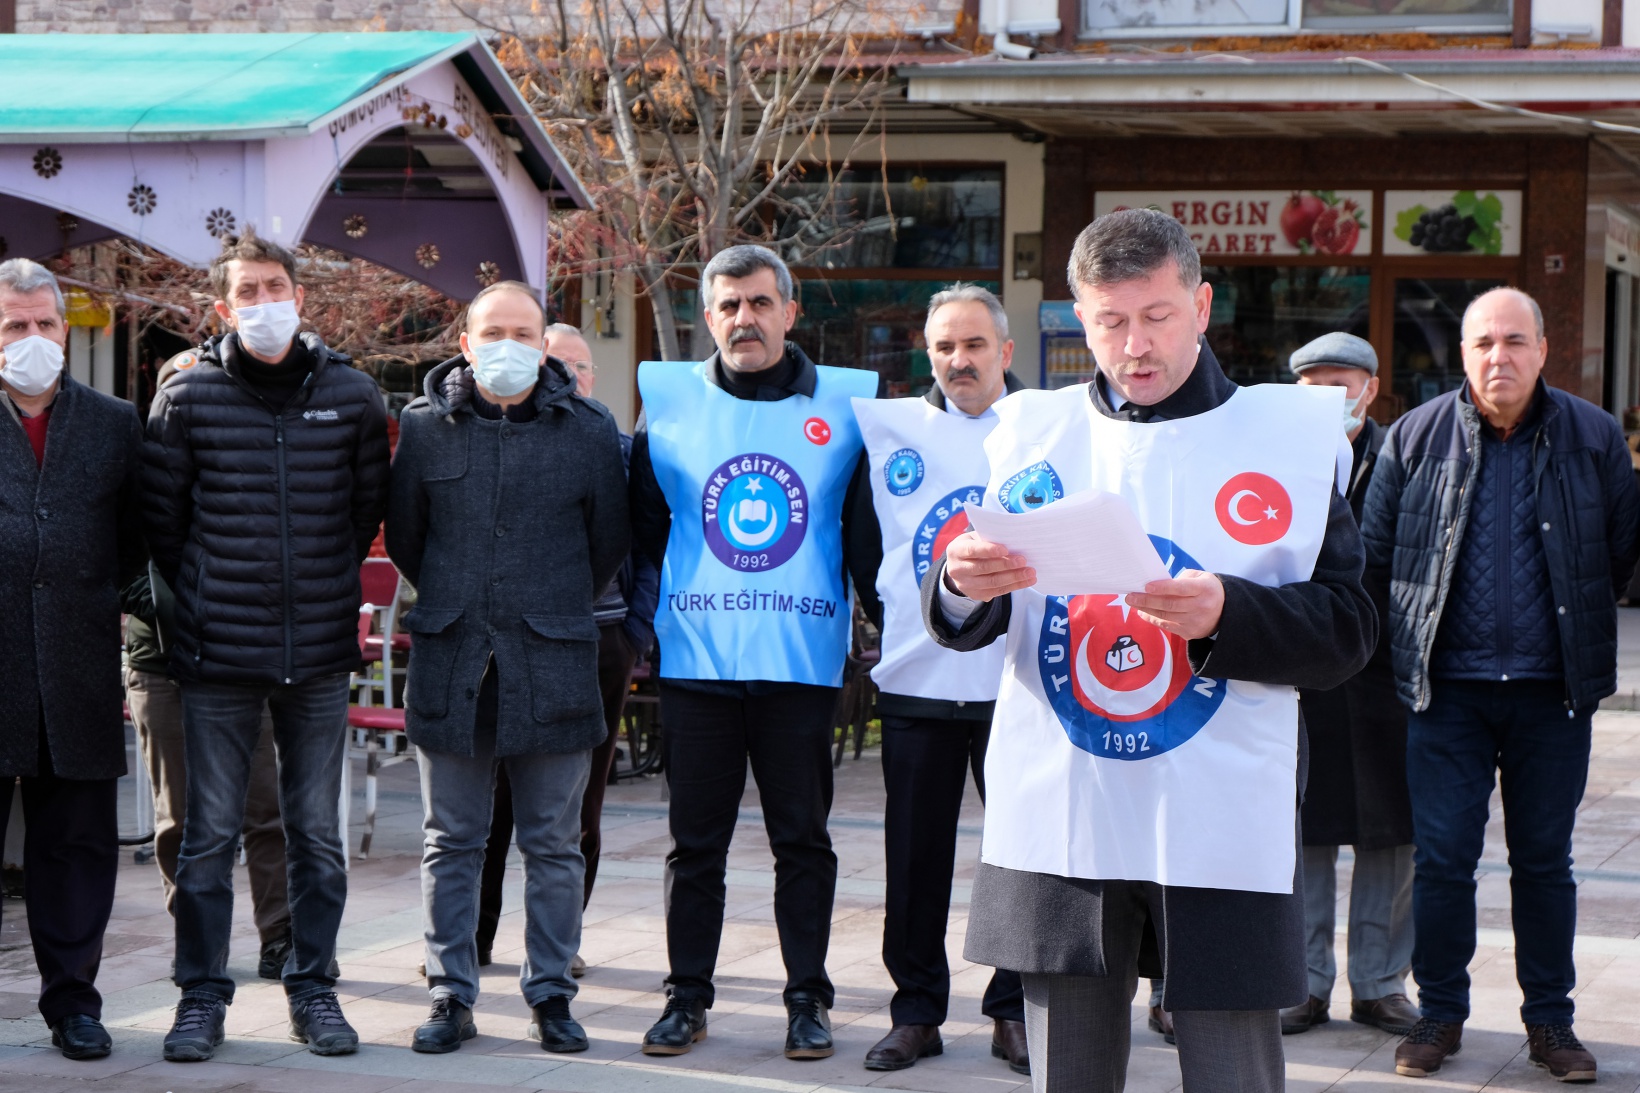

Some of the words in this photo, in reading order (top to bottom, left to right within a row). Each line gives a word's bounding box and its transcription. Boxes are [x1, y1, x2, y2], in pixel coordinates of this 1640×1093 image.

[1190, 233, 1276, 253] CARET
[703, 472, 728, 522] TÜRK
[728, 456, 803, 524] EĞİTİM-SEN
[917, 523, 937, 575] ÜRK
[936, 489, 981, 521] SAĞ
[733, 554, 769, 568] 1992
[668, 590, 717, 612] TÜRK
[723, 589, 837, 618] EĞİTİM-SEN
[1102, 730, 1150, 754] 1992
